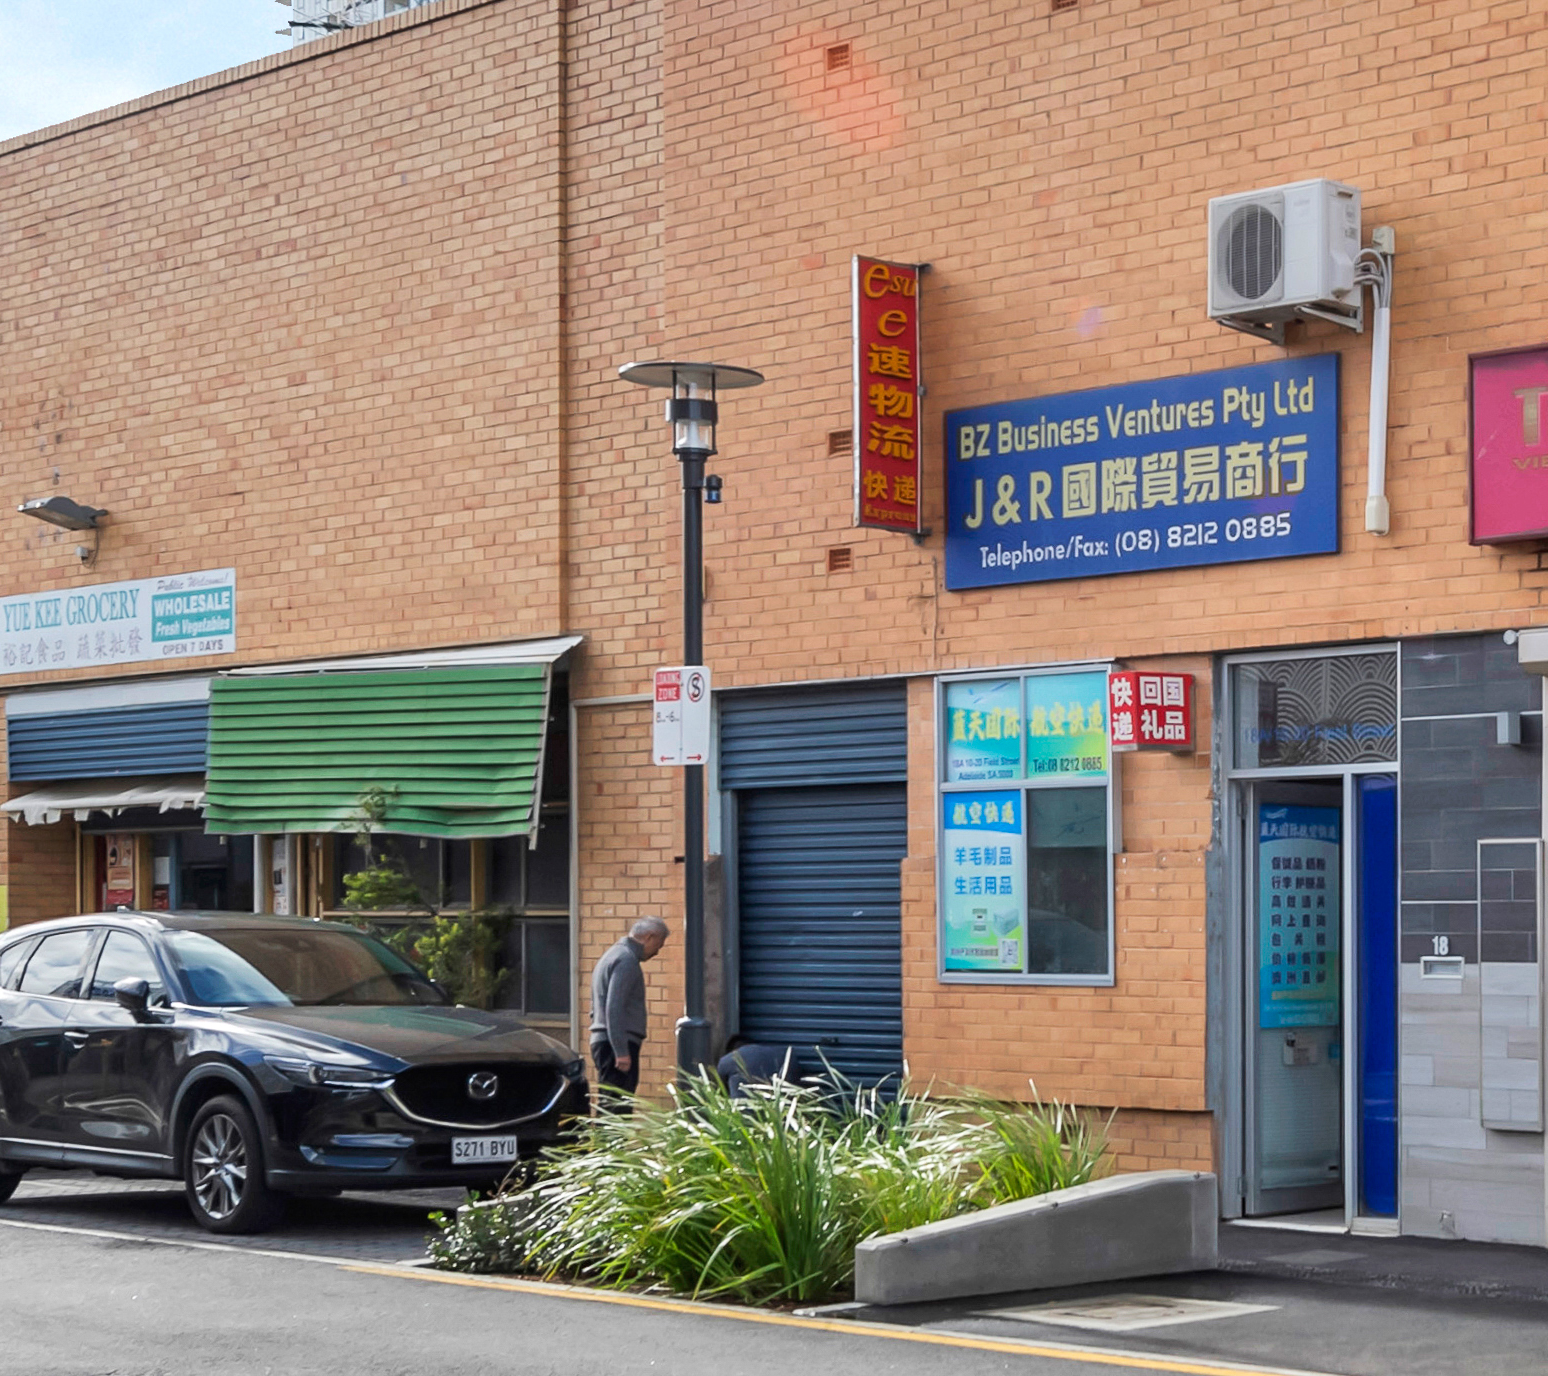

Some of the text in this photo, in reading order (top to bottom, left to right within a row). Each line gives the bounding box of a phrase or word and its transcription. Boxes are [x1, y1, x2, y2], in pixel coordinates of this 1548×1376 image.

[960, 376, 1314, 459] BZ Business Ventures Pty Ltd
[979, 512, 1291, 571] Telephone/Fax: (08) 8212 0885
[3, 588, 140, 633] YUE KEE GROCERY
[154, 590, 231, 618] WHOLESALE
[155, 616, 231, 638] Fresh Vegetables
[163, 638, 223, 655] OPEN 7 DAYS
[1111, 677, 1134, 741] 快递
[1141, 709, 1185, 740] 礼品
[1432, 935, 1449, 956] 18
[455, 1139, 514, 1157] S271 BYU
